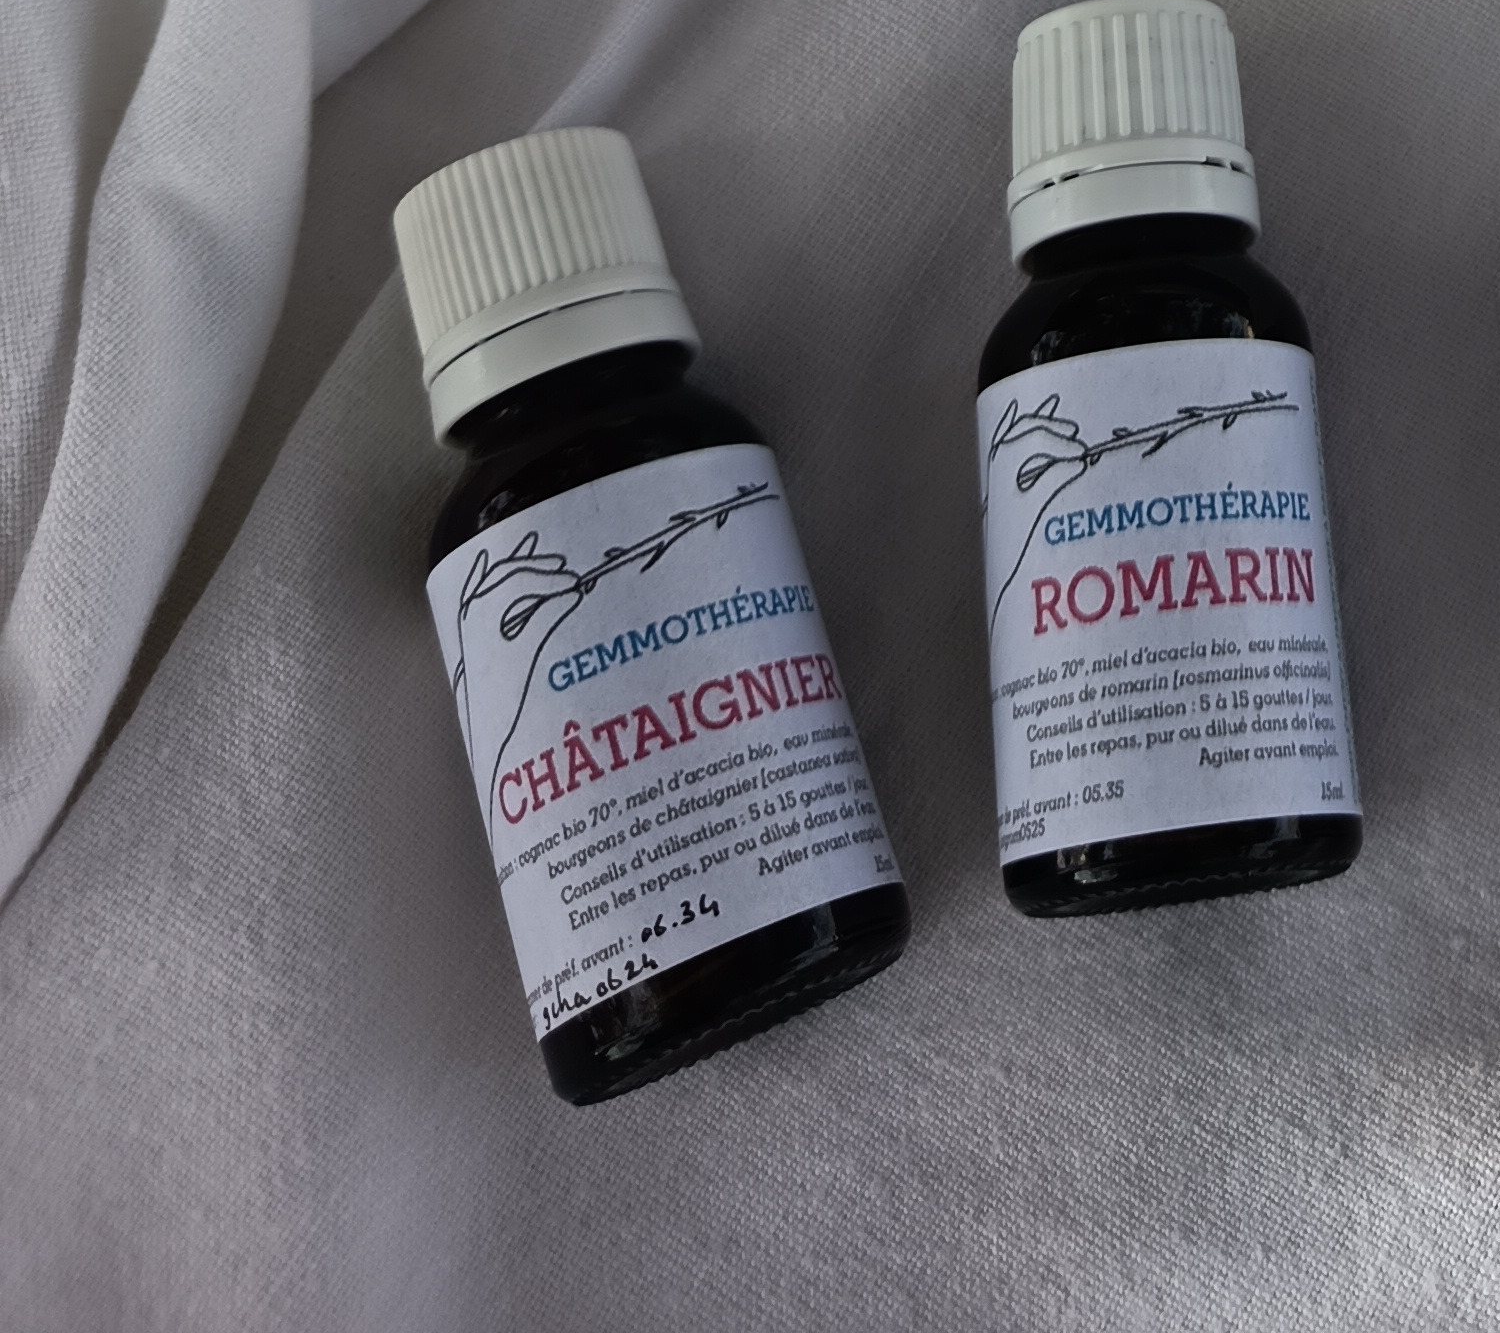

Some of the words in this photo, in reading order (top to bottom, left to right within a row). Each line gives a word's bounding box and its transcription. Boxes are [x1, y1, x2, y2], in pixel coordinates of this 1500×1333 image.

[1044, 482, 1311, 546] GEMMOTHÉRAPIE
[1031, 546, 1316, 636] ROMARIN
[548, 587, 814, 691] GEMMOTHÉRAPIE
[1131, 640, 1207, 666] d'acacia
[1101, 672, 1168, 699] romarin
[499, 653, 841, 824] CHÂTAIGNIER
[1027, 714, 1083, 742] Conseils
[1086, 700, 1186, 728] d'utilisation
[1146, 729, 1175, 749] pur
[626, 778, 664, 807] miel
[667, 751, 745, 792] d'acacia
[1199, 747, 1250, 768] Agiter
[1253, 740, 1297, 760] avant
[548, 830, 626, 879] bourgeons
[629, 816, 652, 838] de
[655, 775, 759, 826] châtaignier
[560, 861, 628, 905] Conseils
[631, 816, 737, 870] d'utilisation
[568, 899, 609, 931] Entre
[610, 888, 637, 910] les
[700, 846, 730, 873] pur
[734, 836, 757, 855] ou
[758, 845, 809, 876] Agiter
